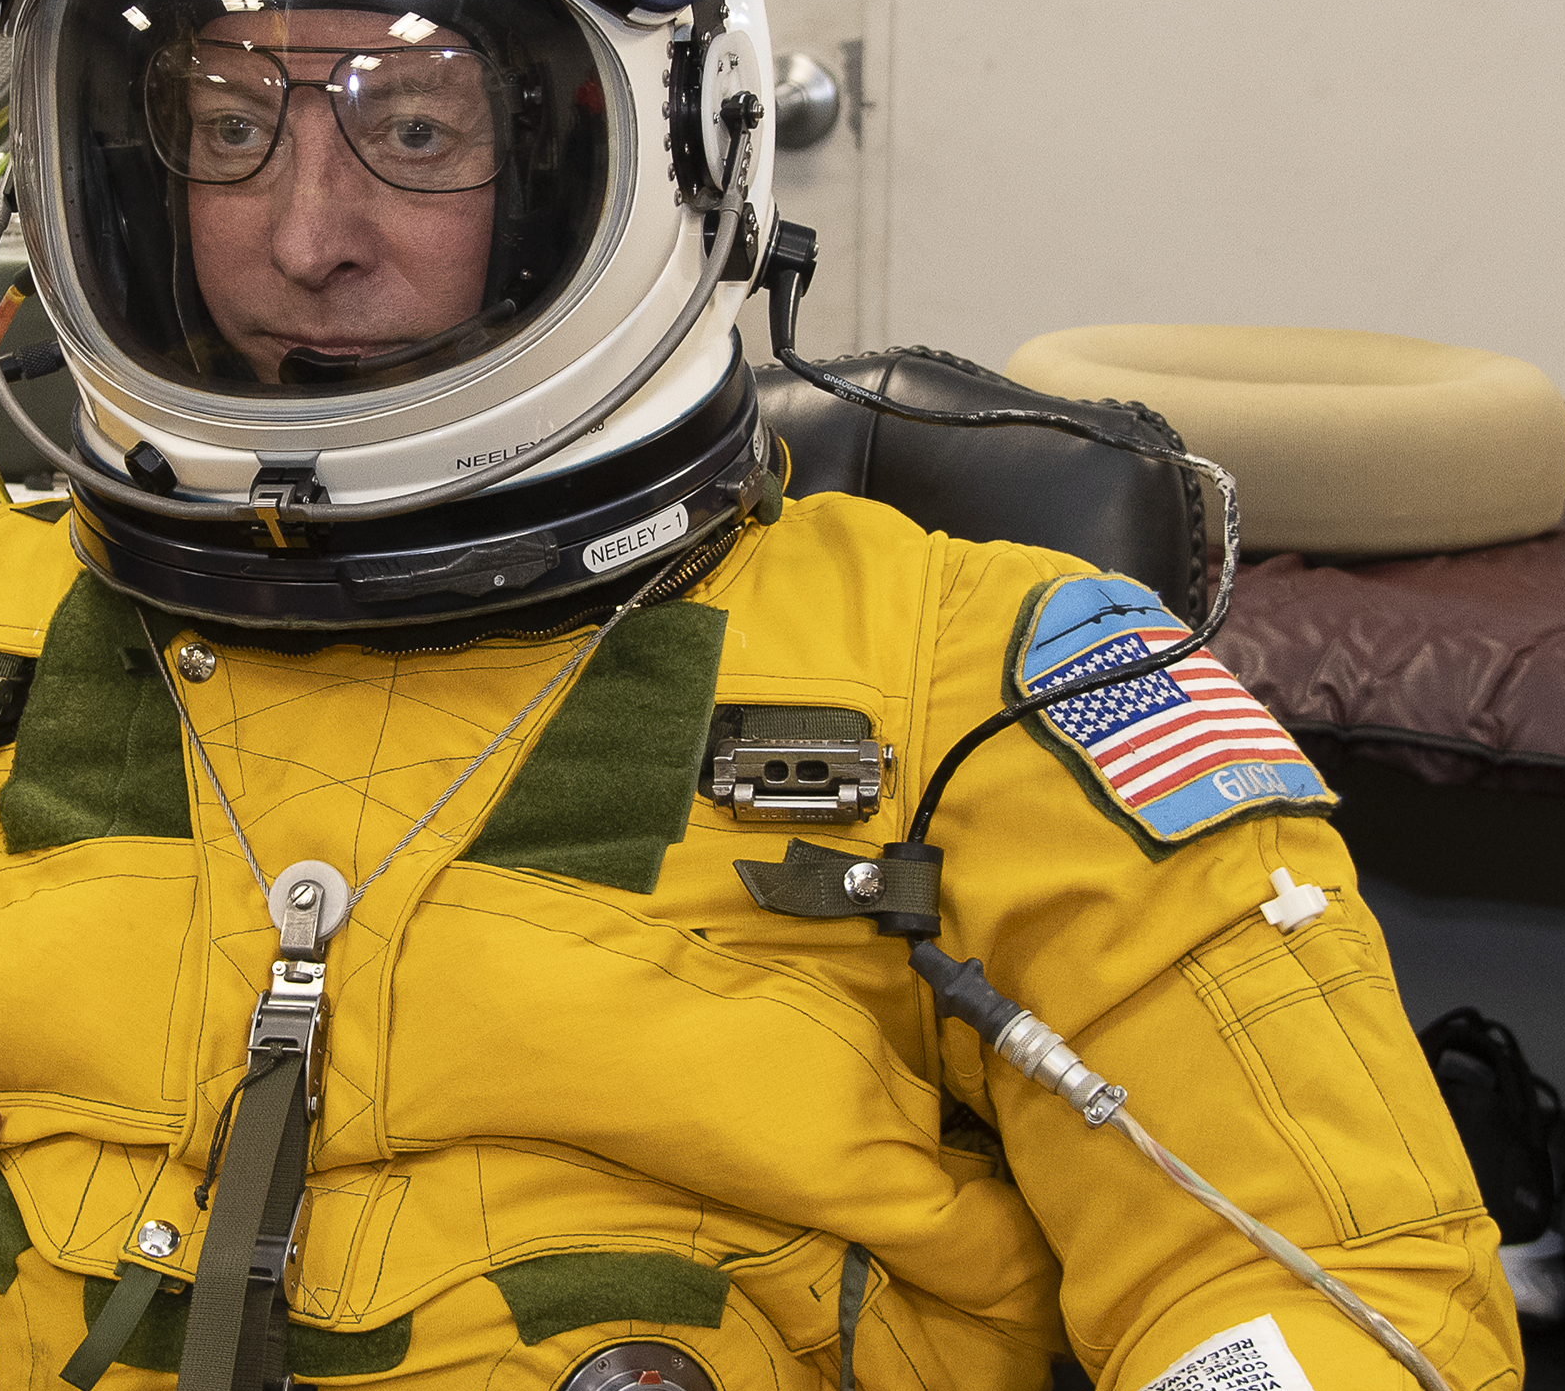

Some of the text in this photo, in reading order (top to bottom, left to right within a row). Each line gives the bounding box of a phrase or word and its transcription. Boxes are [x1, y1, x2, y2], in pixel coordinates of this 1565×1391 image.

[591, 523, 657, 566] NEELEY
[675, 511, 682, 528] 1
[1207, 1361, 1268, 1383] COMM.
[1225, 1371, 1274, 1389] VENT
